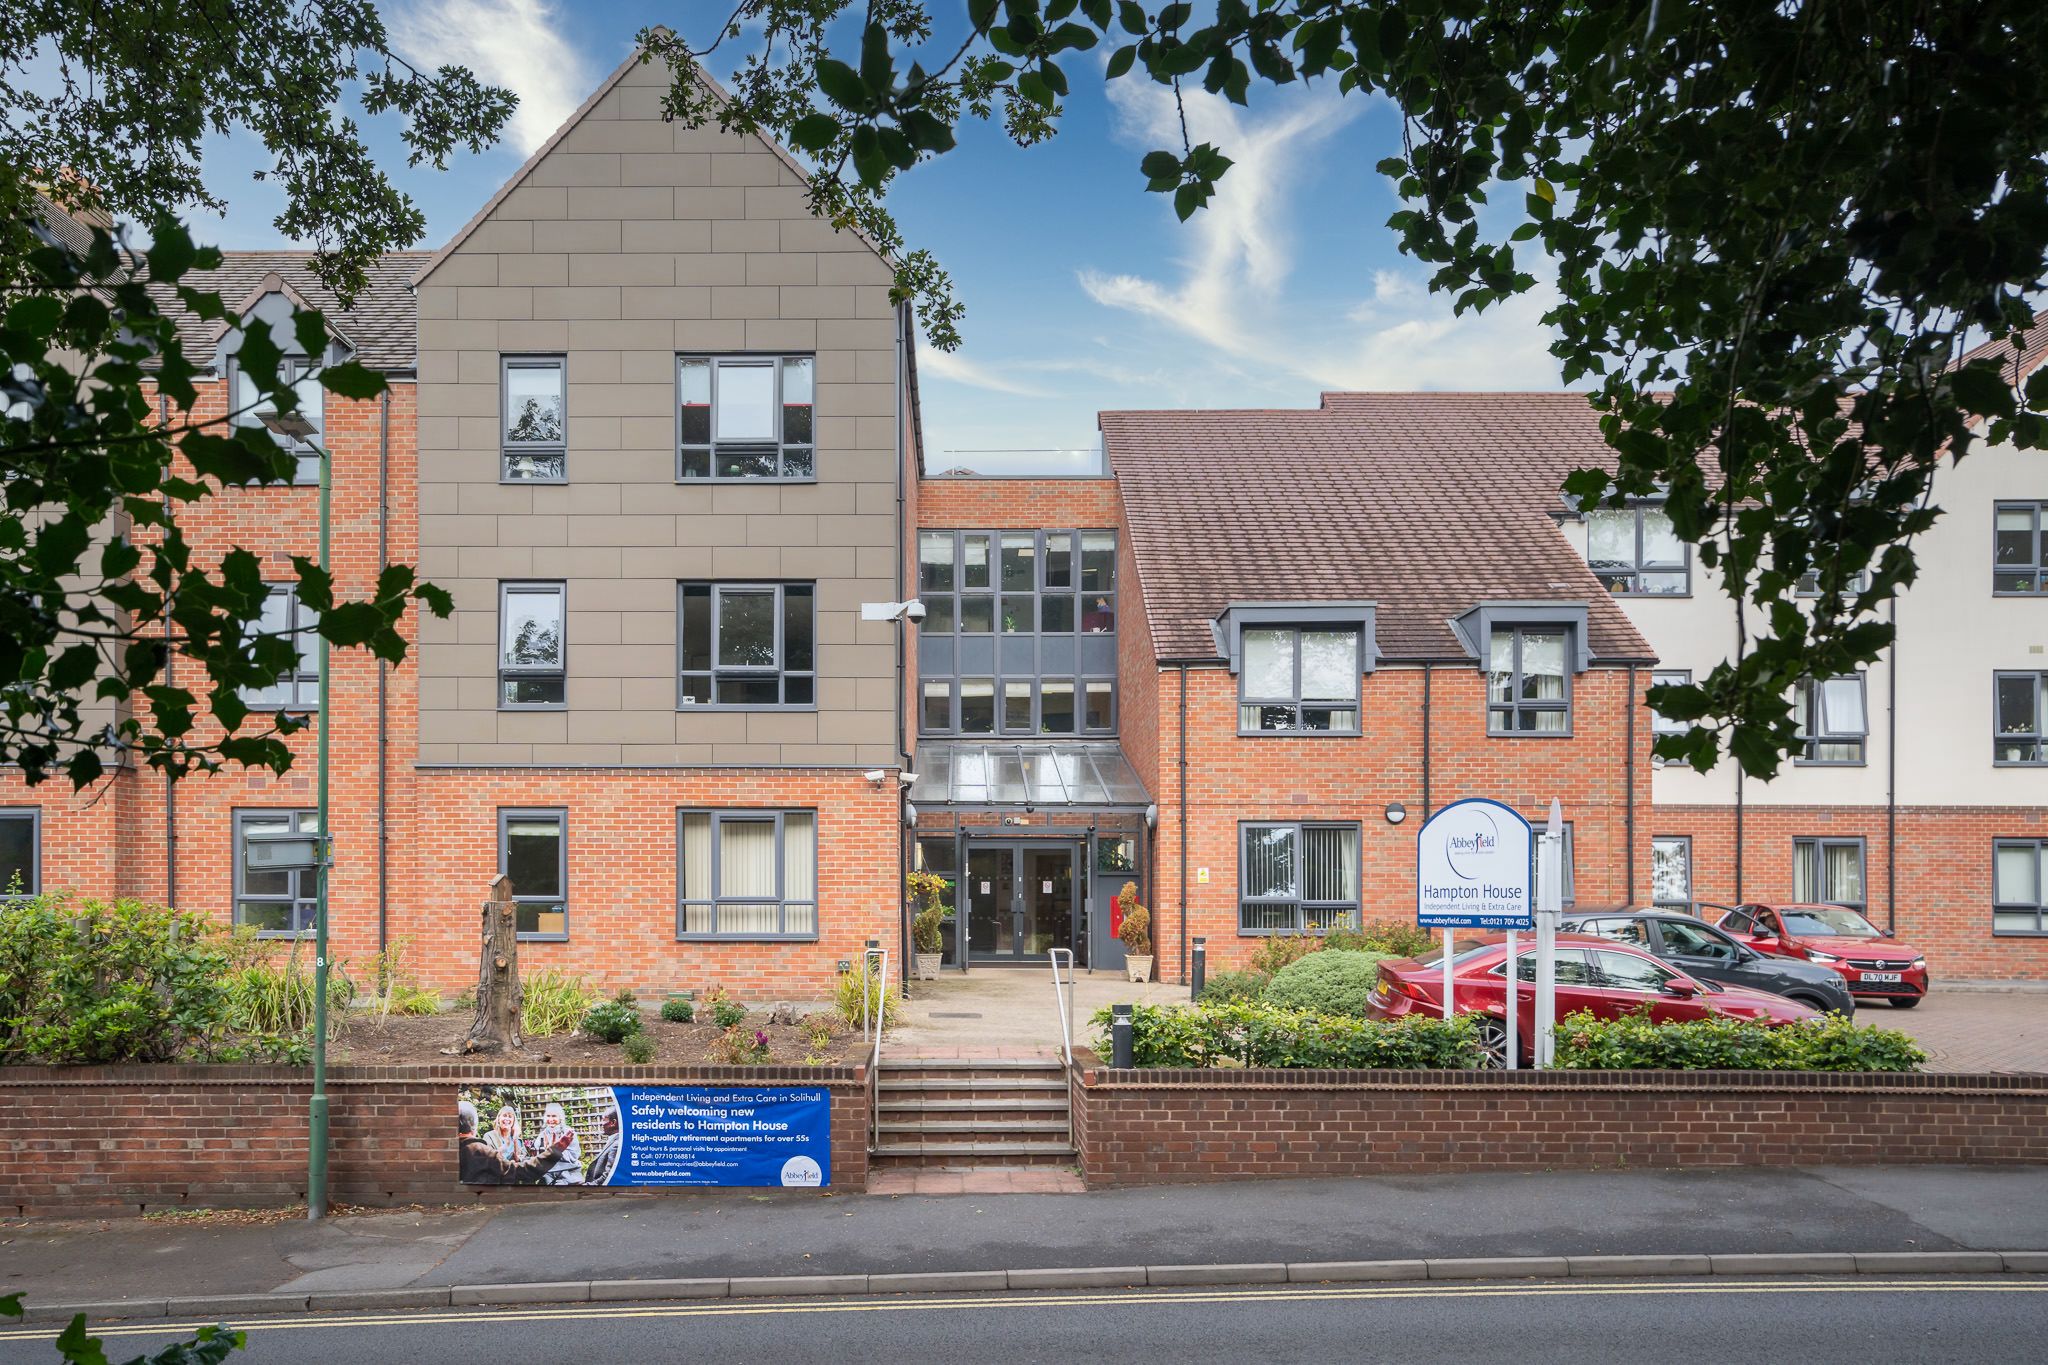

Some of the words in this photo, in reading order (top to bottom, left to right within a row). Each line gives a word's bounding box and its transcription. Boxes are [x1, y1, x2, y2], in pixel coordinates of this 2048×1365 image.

[1450, 833, 1494, 854] Abbeyfield
[1424, 884, 1478, 902] Hampton
[1483, 884, 1522, 898] House
[1424, 903, 1460, 911] Independent
[1462, 903, 1480, 912] Living
[1481, 903, 1486, 911] &
[1488, 903, 1504, 911] Extra
[1506, 903, 1522, 911] Care
[1420, 918, 1472, 926] www.abbeyfield.com
[317, 956, 324, 966] 8
[632, 1092, 684, 1102] Independent
[686, 1094, 710, 1104] Living
[713, 1094, 729, 1102] and
[732, 1094, 753, 1102] Extra
[756, 1094, 777, 1102] Care
[780, 1094, 788, 1102] in
[790, 1092, 821, 1102] Solihull
[632, 1105, 665, 1118] Safely
[668, 1106, 727, 1118] welcoming
[731, 1108, 755, 1116] new
[632, 1119, 681, 1130] residents
[684, 1120, 695, 1130] to
[698, 1120, 749, 1132] Hampton
[753, 1120, 788, 1130] House
[632, 1134, 678, 1143] High-quality
[680, 1134, 718, 1142] retirement
[720, 1135, 762, 1143] apartments
